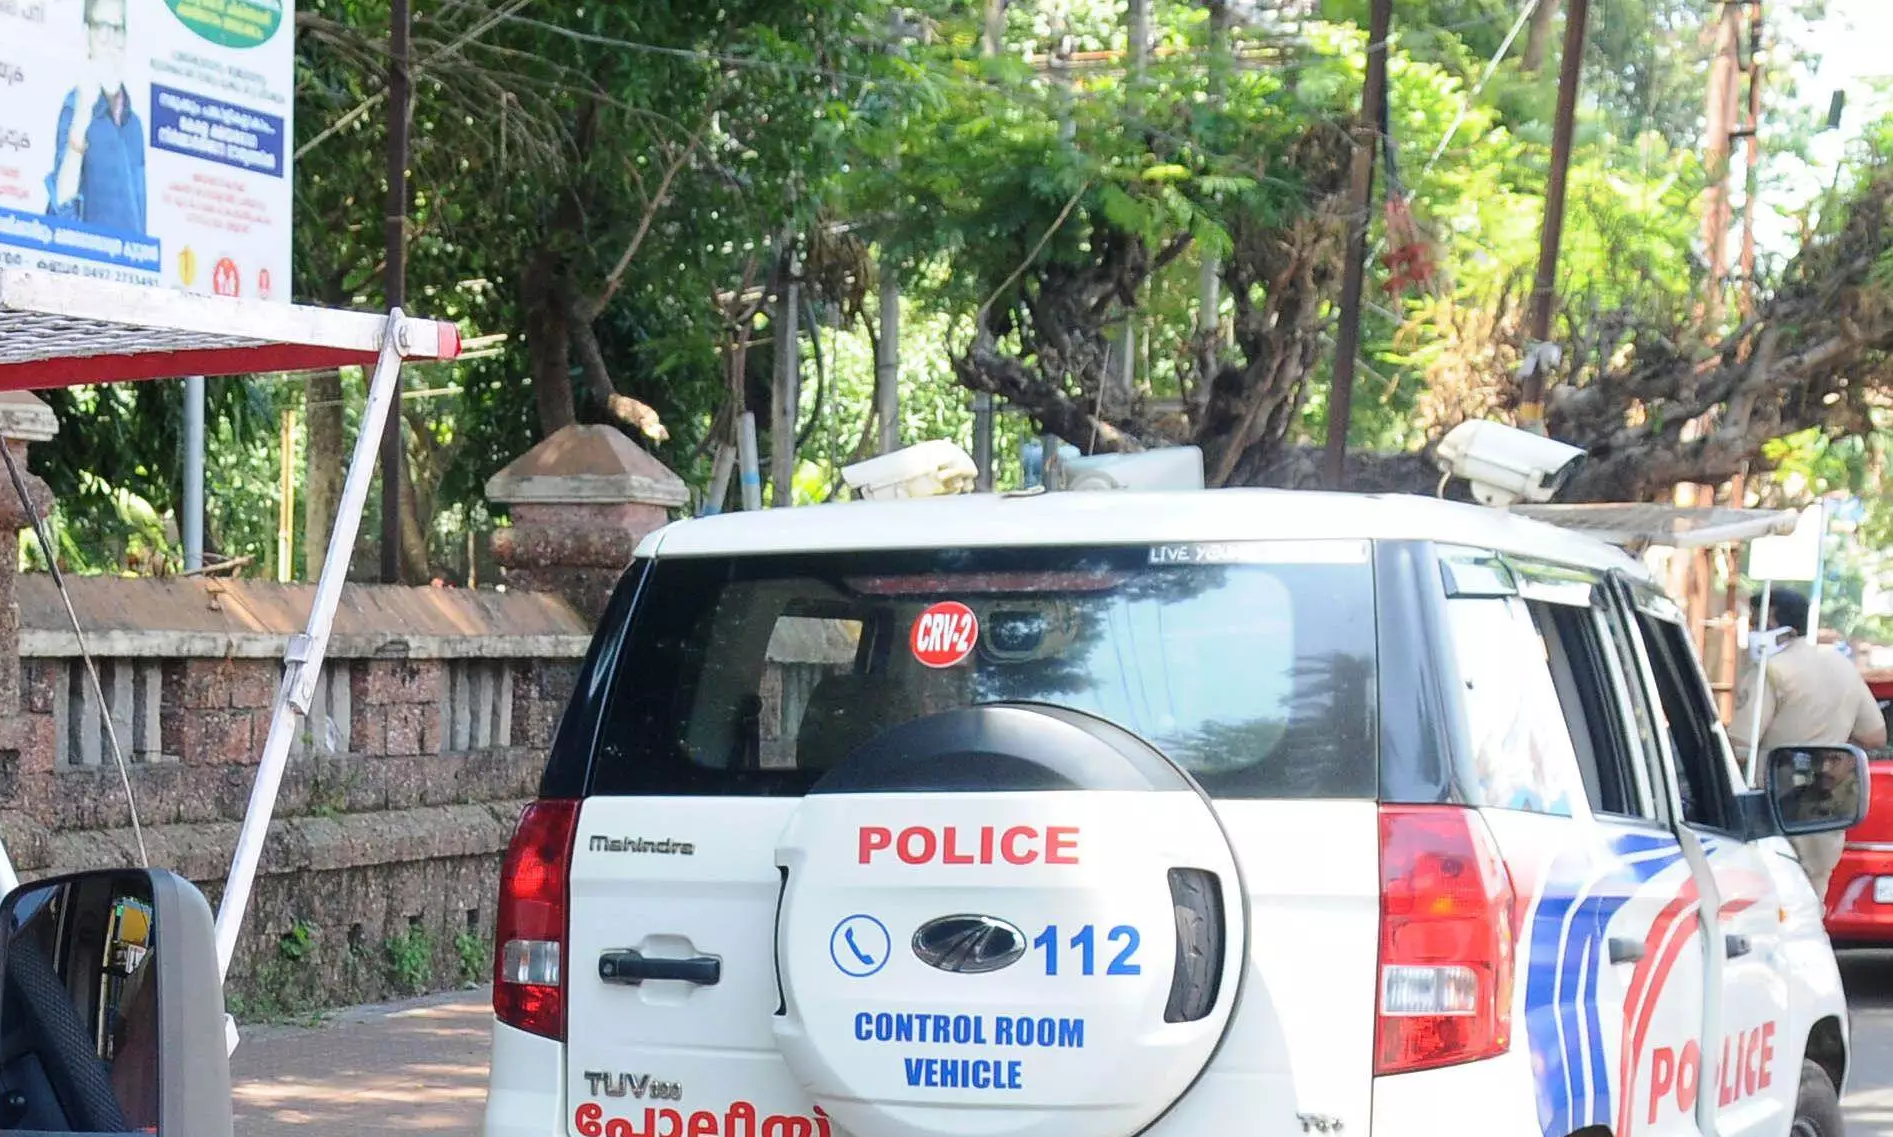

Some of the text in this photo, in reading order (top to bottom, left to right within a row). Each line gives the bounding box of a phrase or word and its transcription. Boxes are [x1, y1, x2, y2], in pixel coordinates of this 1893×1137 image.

[1151, 546, 1190, 563] LIVE
[917, 613, 972, 652] CRV-2
[589, 835, 694, 855] Mahindra
[858, 826, 1080, 865] POLICE
[1034, 924, 1141, 976] 112
[854, 1012, 1084, 1048] CONTROL ROOM
[904, 1058, 1023, 1089] VEHICLE
[1647, 1020, 1776, 1124] POLICE
